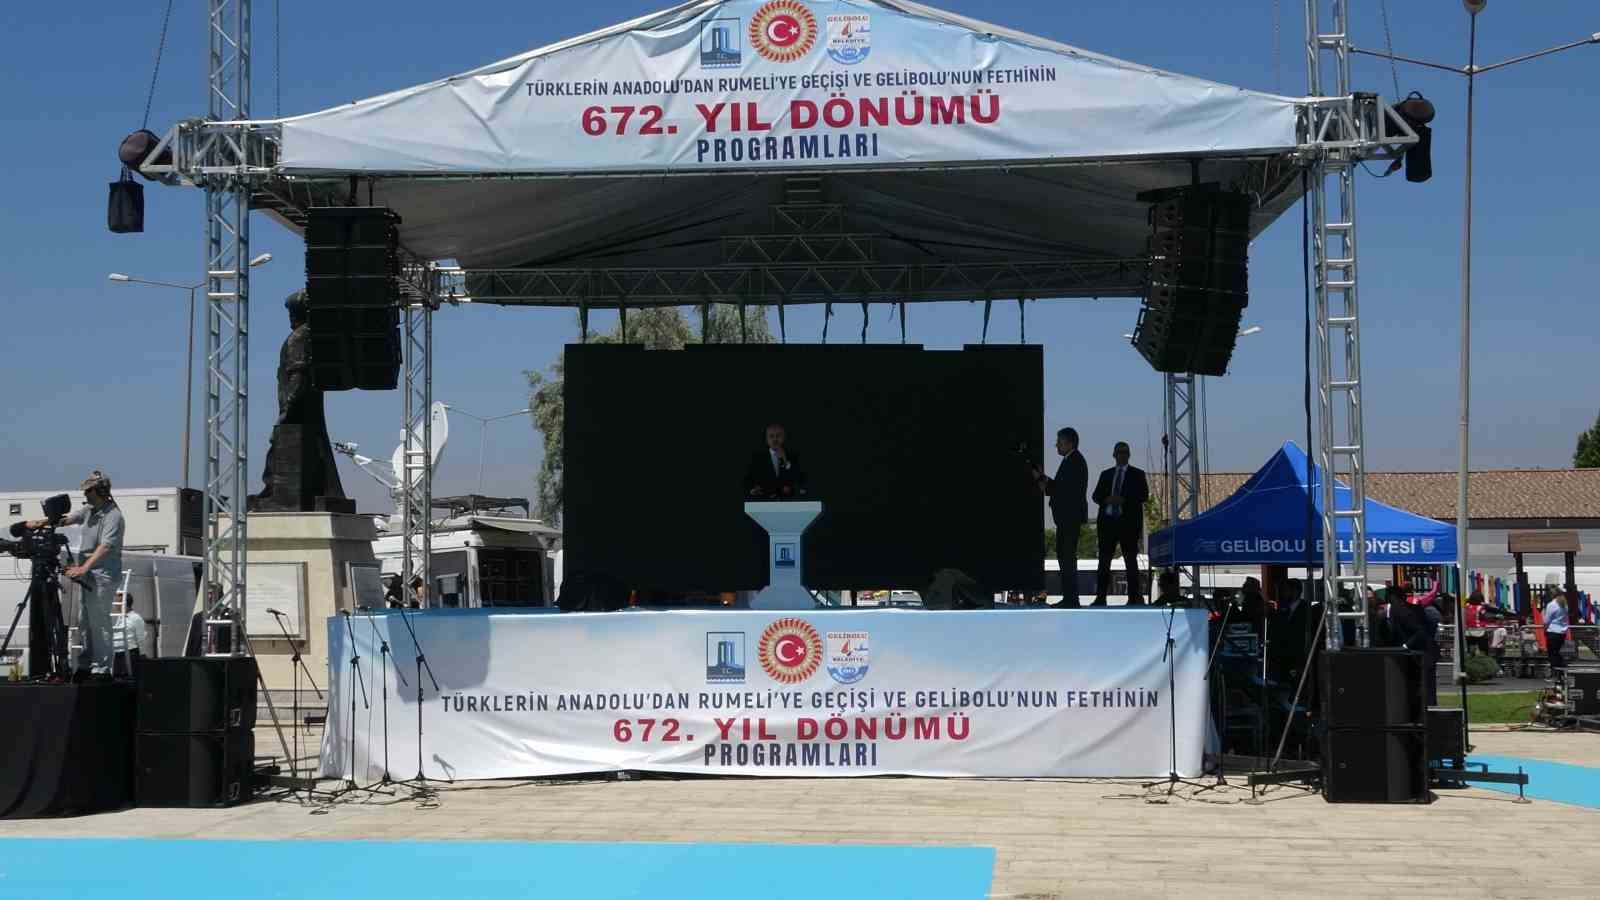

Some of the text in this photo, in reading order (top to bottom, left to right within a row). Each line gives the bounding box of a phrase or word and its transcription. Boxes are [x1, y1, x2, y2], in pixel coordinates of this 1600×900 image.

[526, 65, 1056, 96] TÜRKLERİN ANADOLU'DAN RUMELİ'YE GEÇİŞİ VE GELİBOLU'NUN FETHİNİN
[581, 89, 1000, 136] 672. YIL DÖNÜMÜ
[697, 133, 878, 162] PROGRAMLARI
[1220, 538, 1306, 553] GELİBOLU
[442, 687, 1159, 713] TÜRKLERİN ANADOLU'DAN RUMELİ'YE GEÇİŞİ VE GELİBOLU'NUN FETHİNİN
[613, 712, 970, 743] 672. YIL DÖNÜMÜ
[704, 743, 878, 767] PROGRAMLARI
